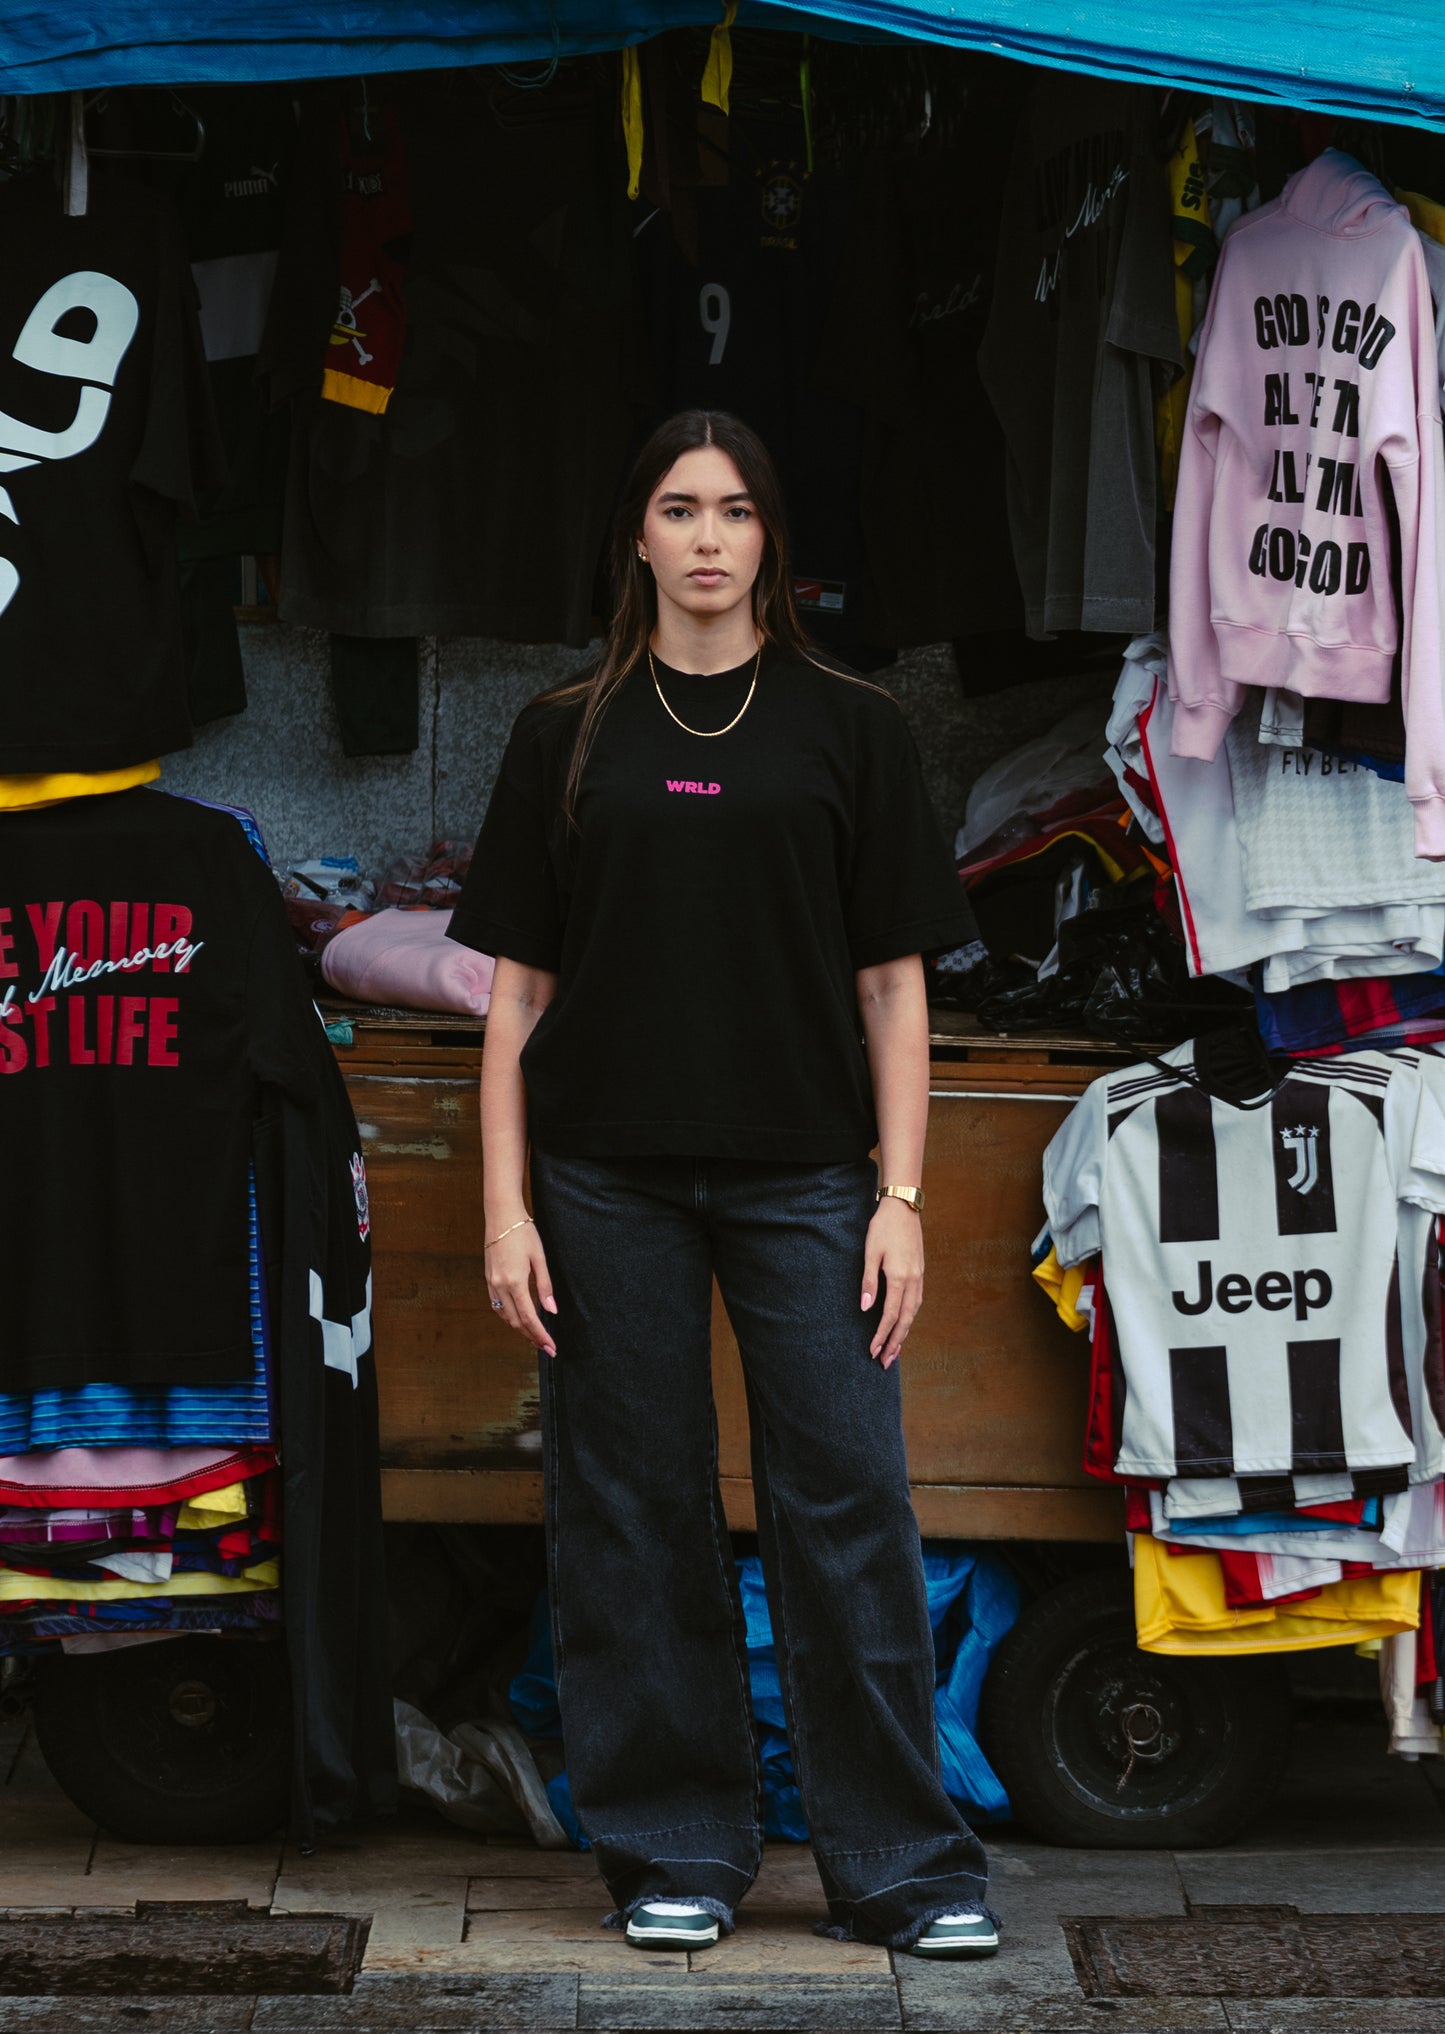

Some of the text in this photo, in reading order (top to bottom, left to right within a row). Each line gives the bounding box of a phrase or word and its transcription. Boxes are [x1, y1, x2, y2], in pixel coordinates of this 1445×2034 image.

[224, 178, 269, 198] PUMA
[699, 282, 731, 366] 9
[665, 779, 722, 796] WRLD
[25, 899, 194, 974] YOUR
[28, 938, 206, 1004] Memory
[68, 995, 180, 1067] LIFE
[1172, 1260, 1333, 1321] Jeep
